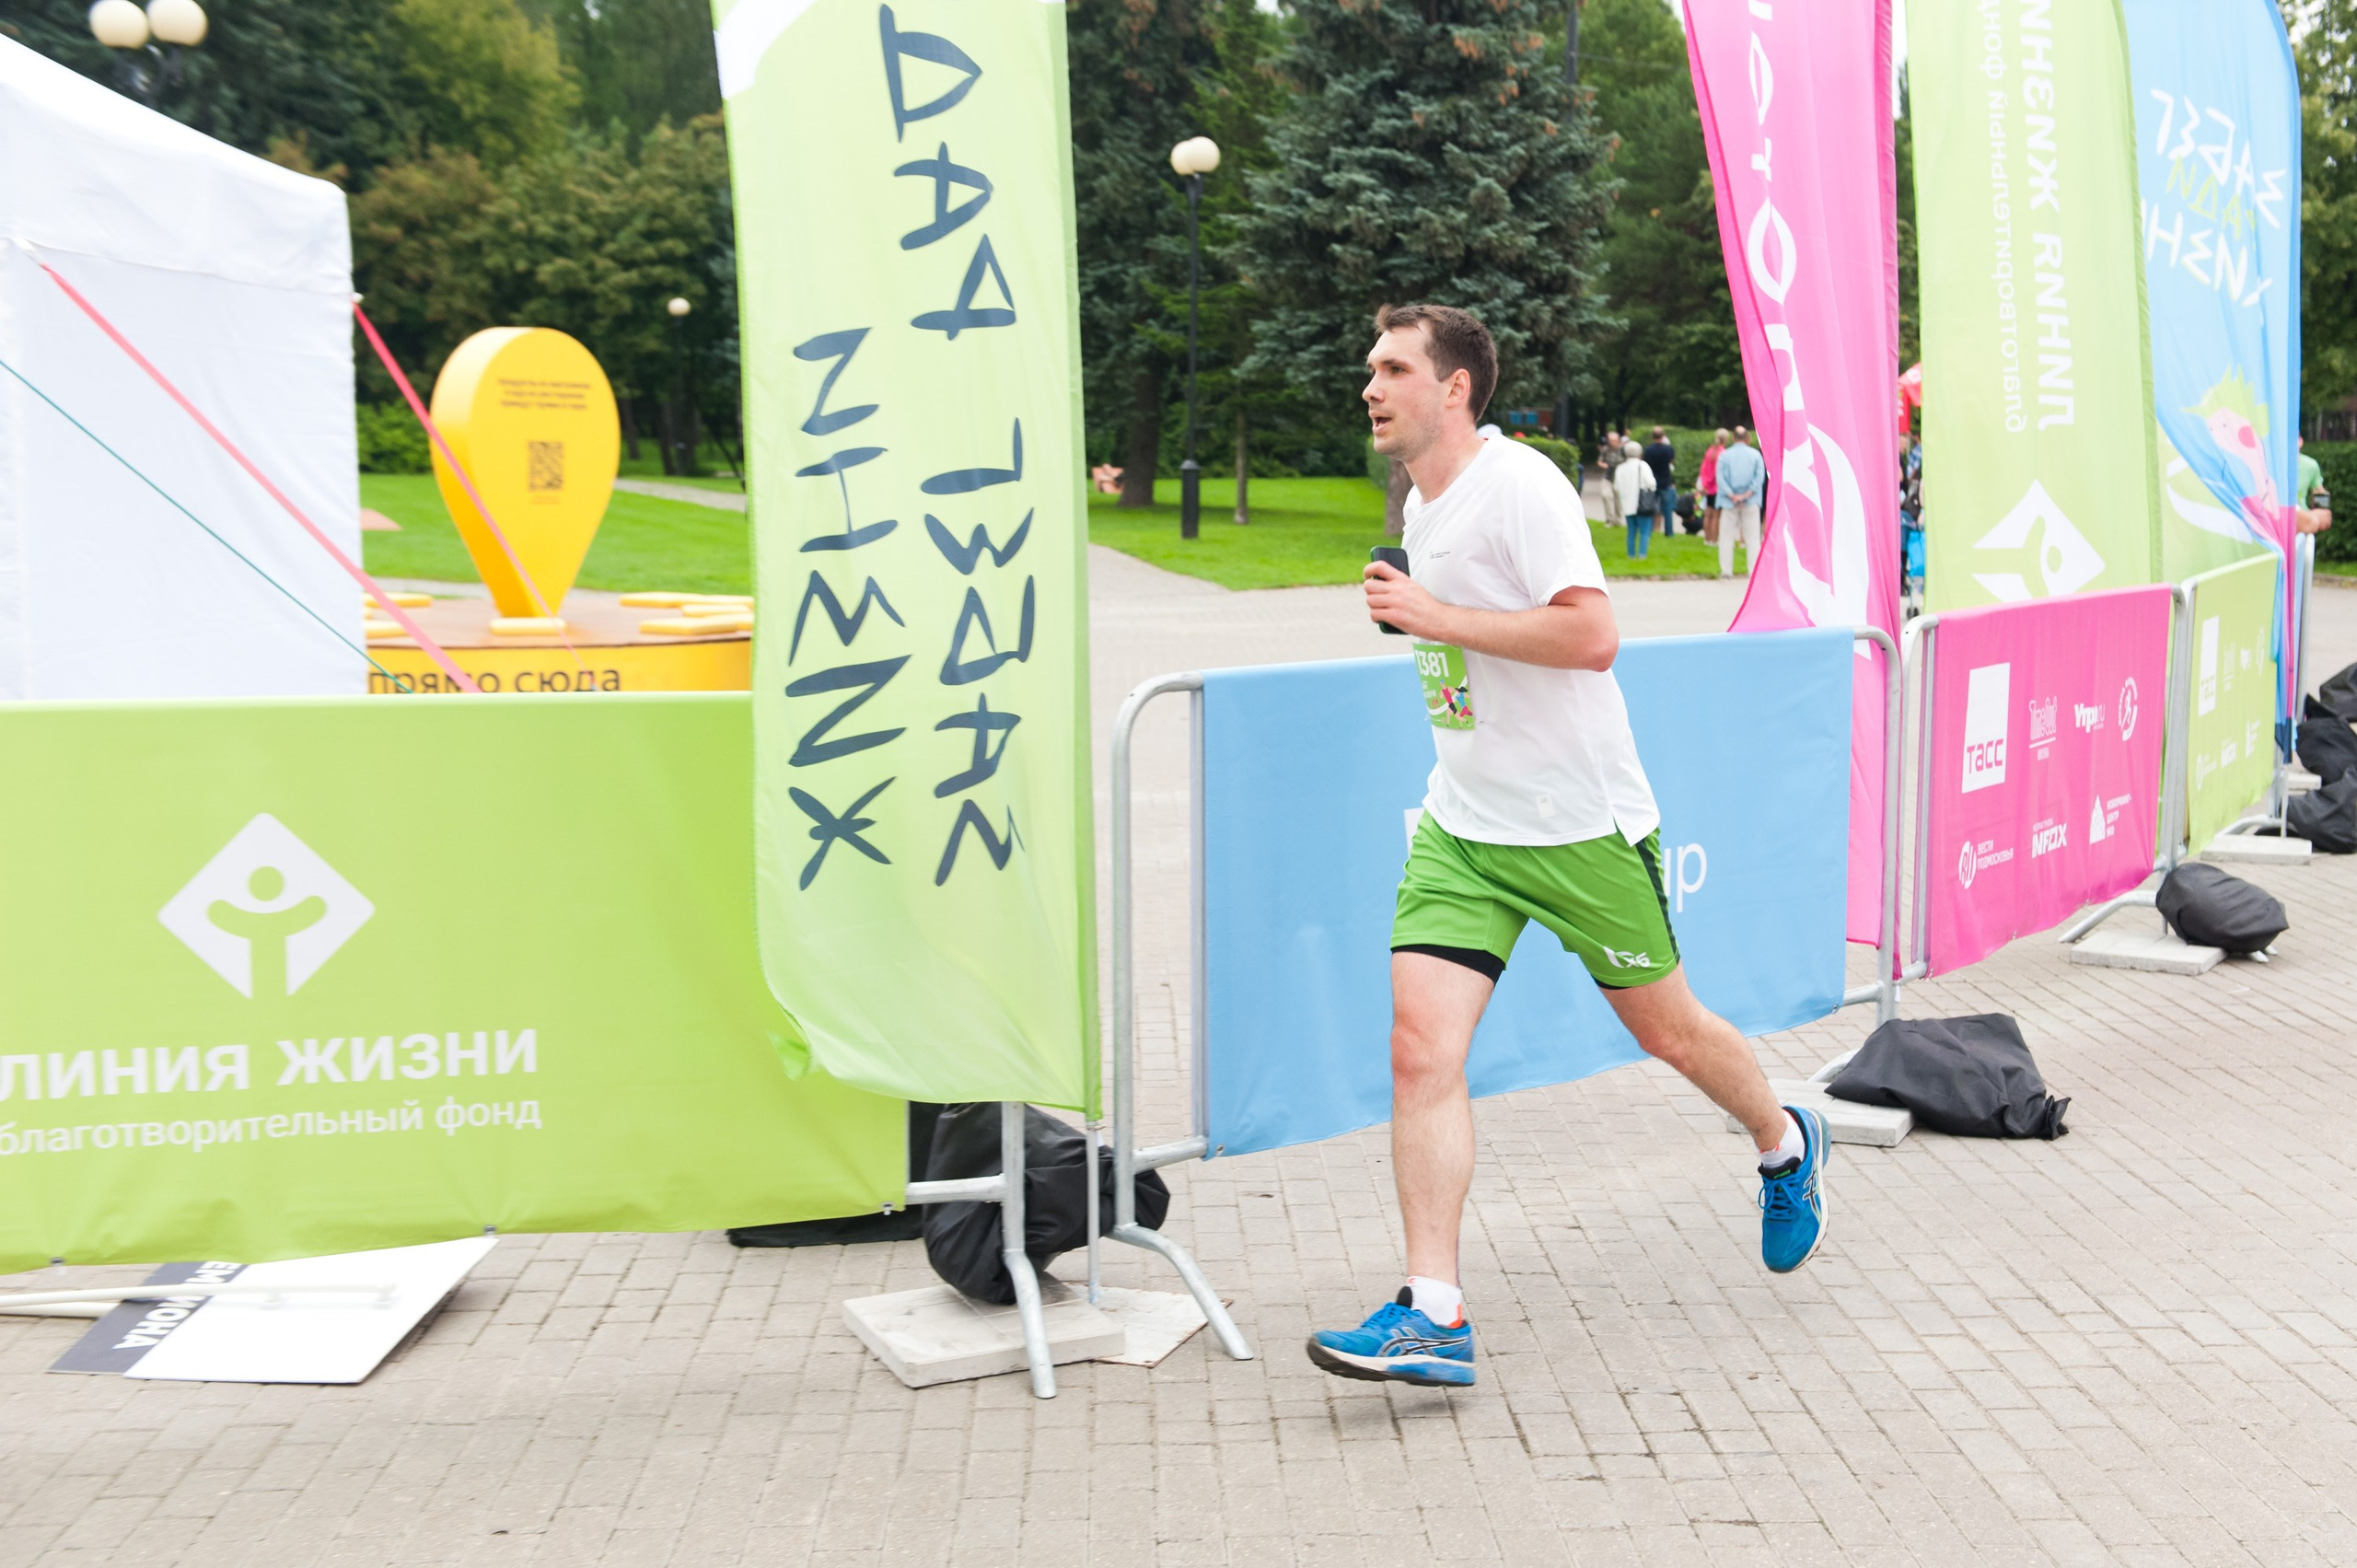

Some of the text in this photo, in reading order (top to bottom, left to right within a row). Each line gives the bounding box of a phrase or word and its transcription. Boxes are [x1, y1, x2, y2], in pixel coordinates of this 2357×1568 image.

[1414, 649, 1450, 678] 1381
[0, 1027, 539, 1102] ЛИНИЯ ЖИЗНИ
[0, 1095, 543, 1156] благотворительный фонд
